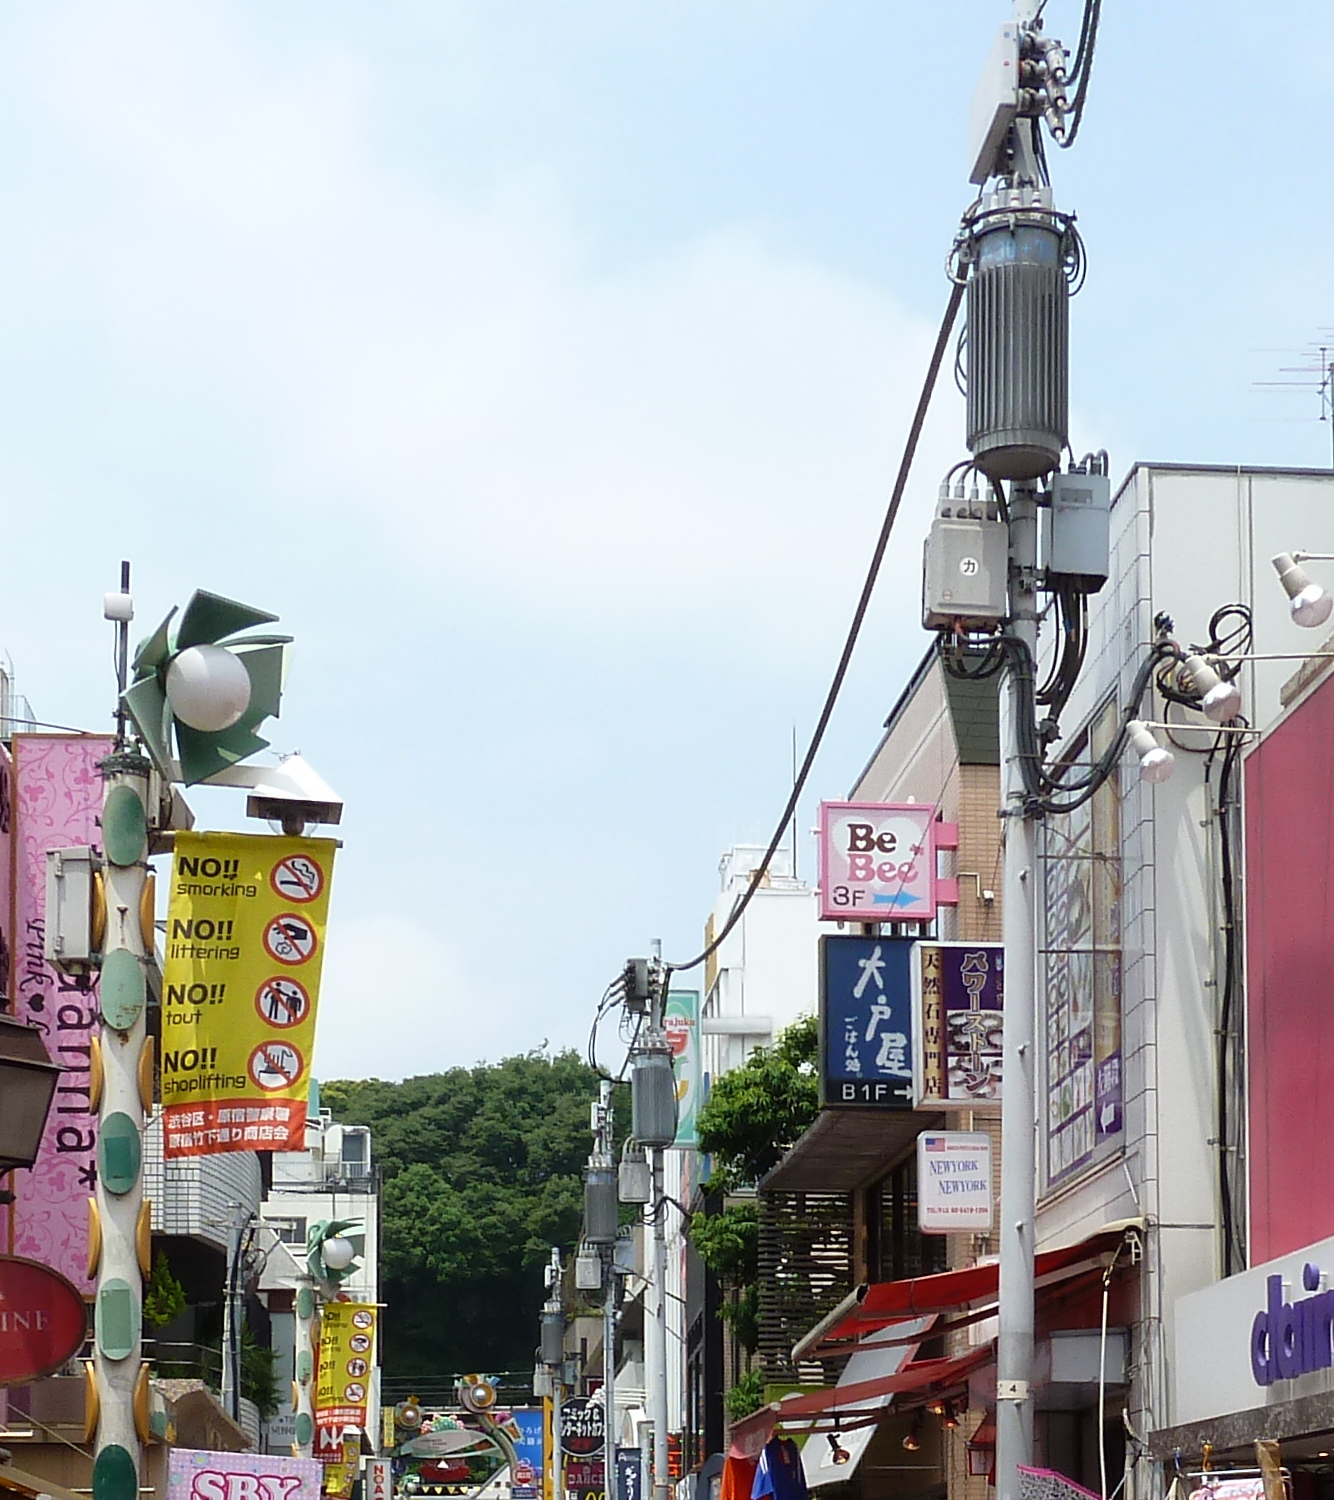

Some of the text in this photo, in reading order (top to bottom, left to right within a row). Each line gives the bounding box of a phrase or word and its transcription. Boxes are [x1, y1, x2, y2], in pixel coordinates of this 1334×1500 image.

[847, 824, 897, 853] Be
[178, 856, 240, 879] NO!!
[847, 854, 919, 884] Bee
[177, 882, 257, 898] smorking
[833, 886, 866, 907] 3F
[173, 919, 233, 941] NO!!
[170, 943, 240, 960] littering
[167, 983, 225, 1006] NO!!
[167, 1009, 203, 1026] tout
[853, 945, 913, 1078] 大戸屋
[961, 951, 989, 1094] パワーストーン
[923, 952, 942, 1095] 天然石専門店
[164, 1048, 217, 1074] NO!!
[164, 1074, 246, 1095] shoplifting
[930, 1160, 979, 1176] NEWYORK
[939, 1180, 987, 1195] NEWYORK
